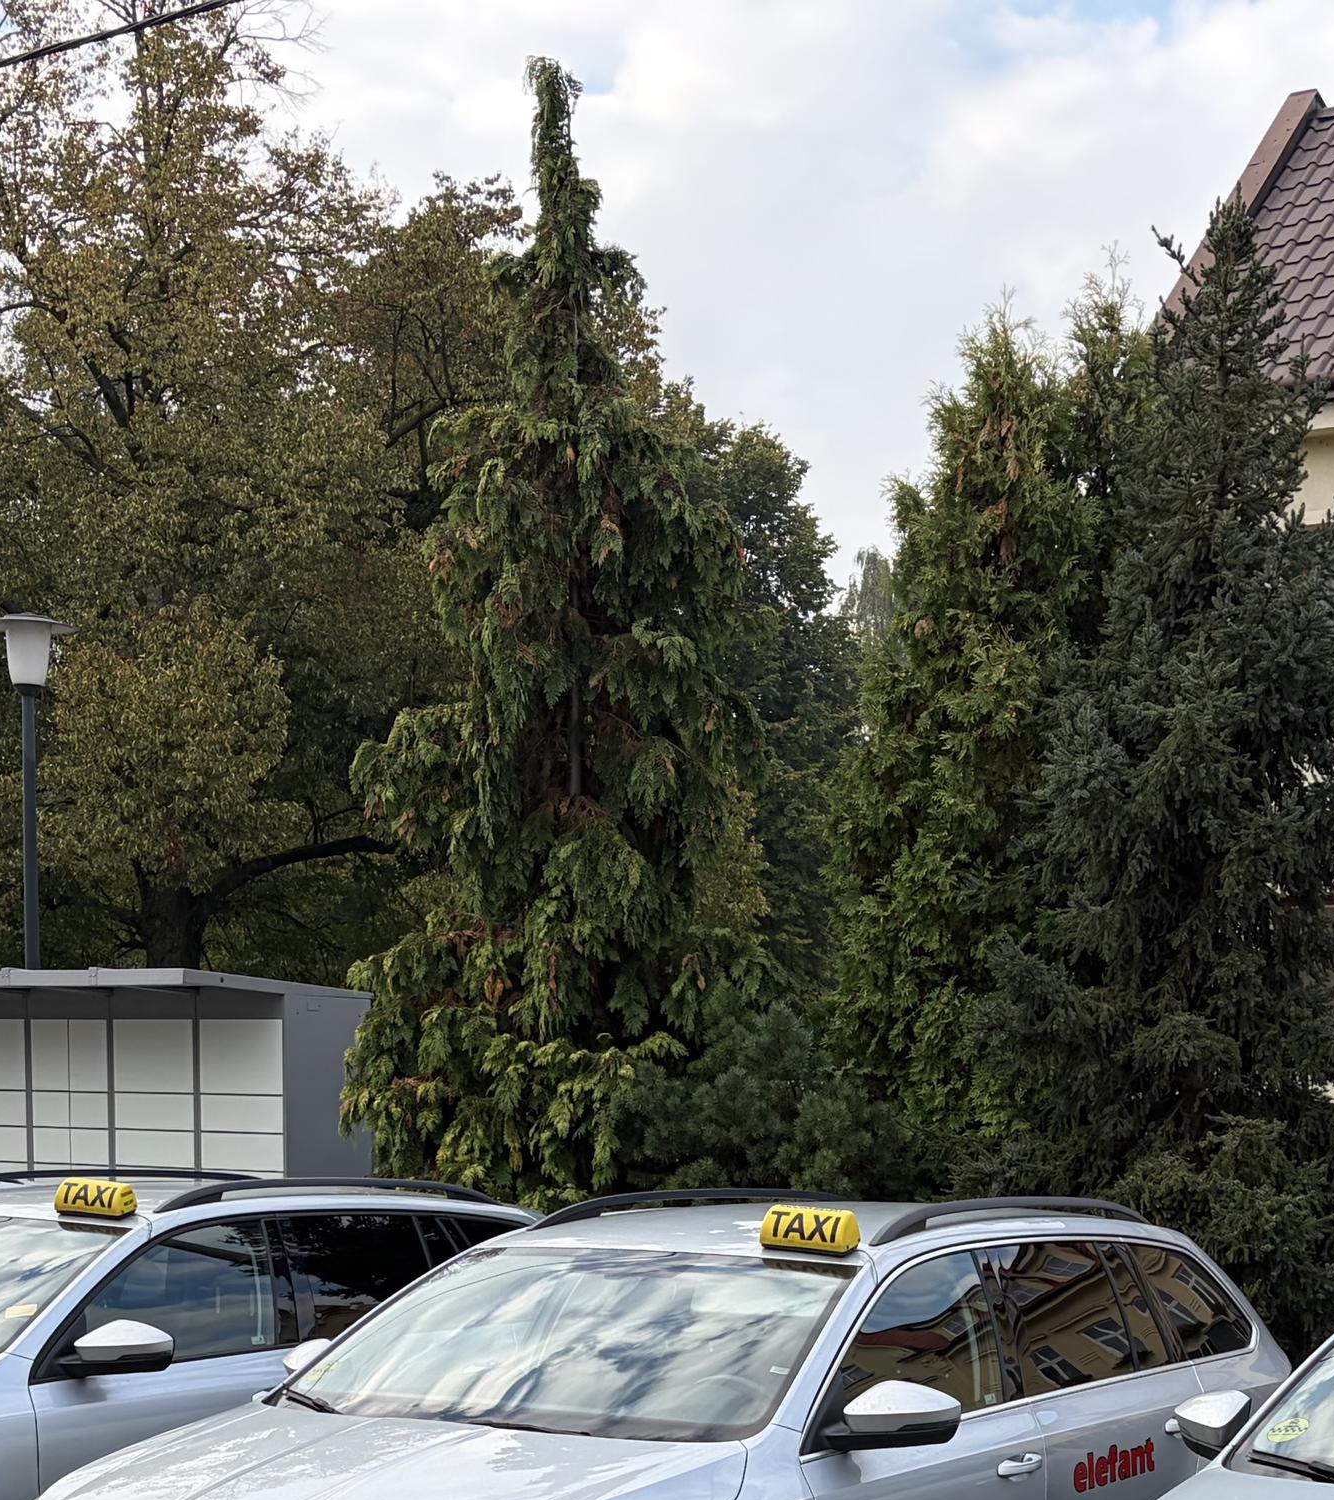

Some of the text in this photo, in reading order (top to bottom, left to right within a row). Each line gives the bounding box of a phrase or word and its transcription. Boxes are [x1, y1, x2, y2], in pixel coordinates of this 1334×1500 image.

[64, 1182, 118, 1209] TAXI
[771, 1210, 841, 1243] TAXI
[1073, 1437, 1155, 1493] elefant
